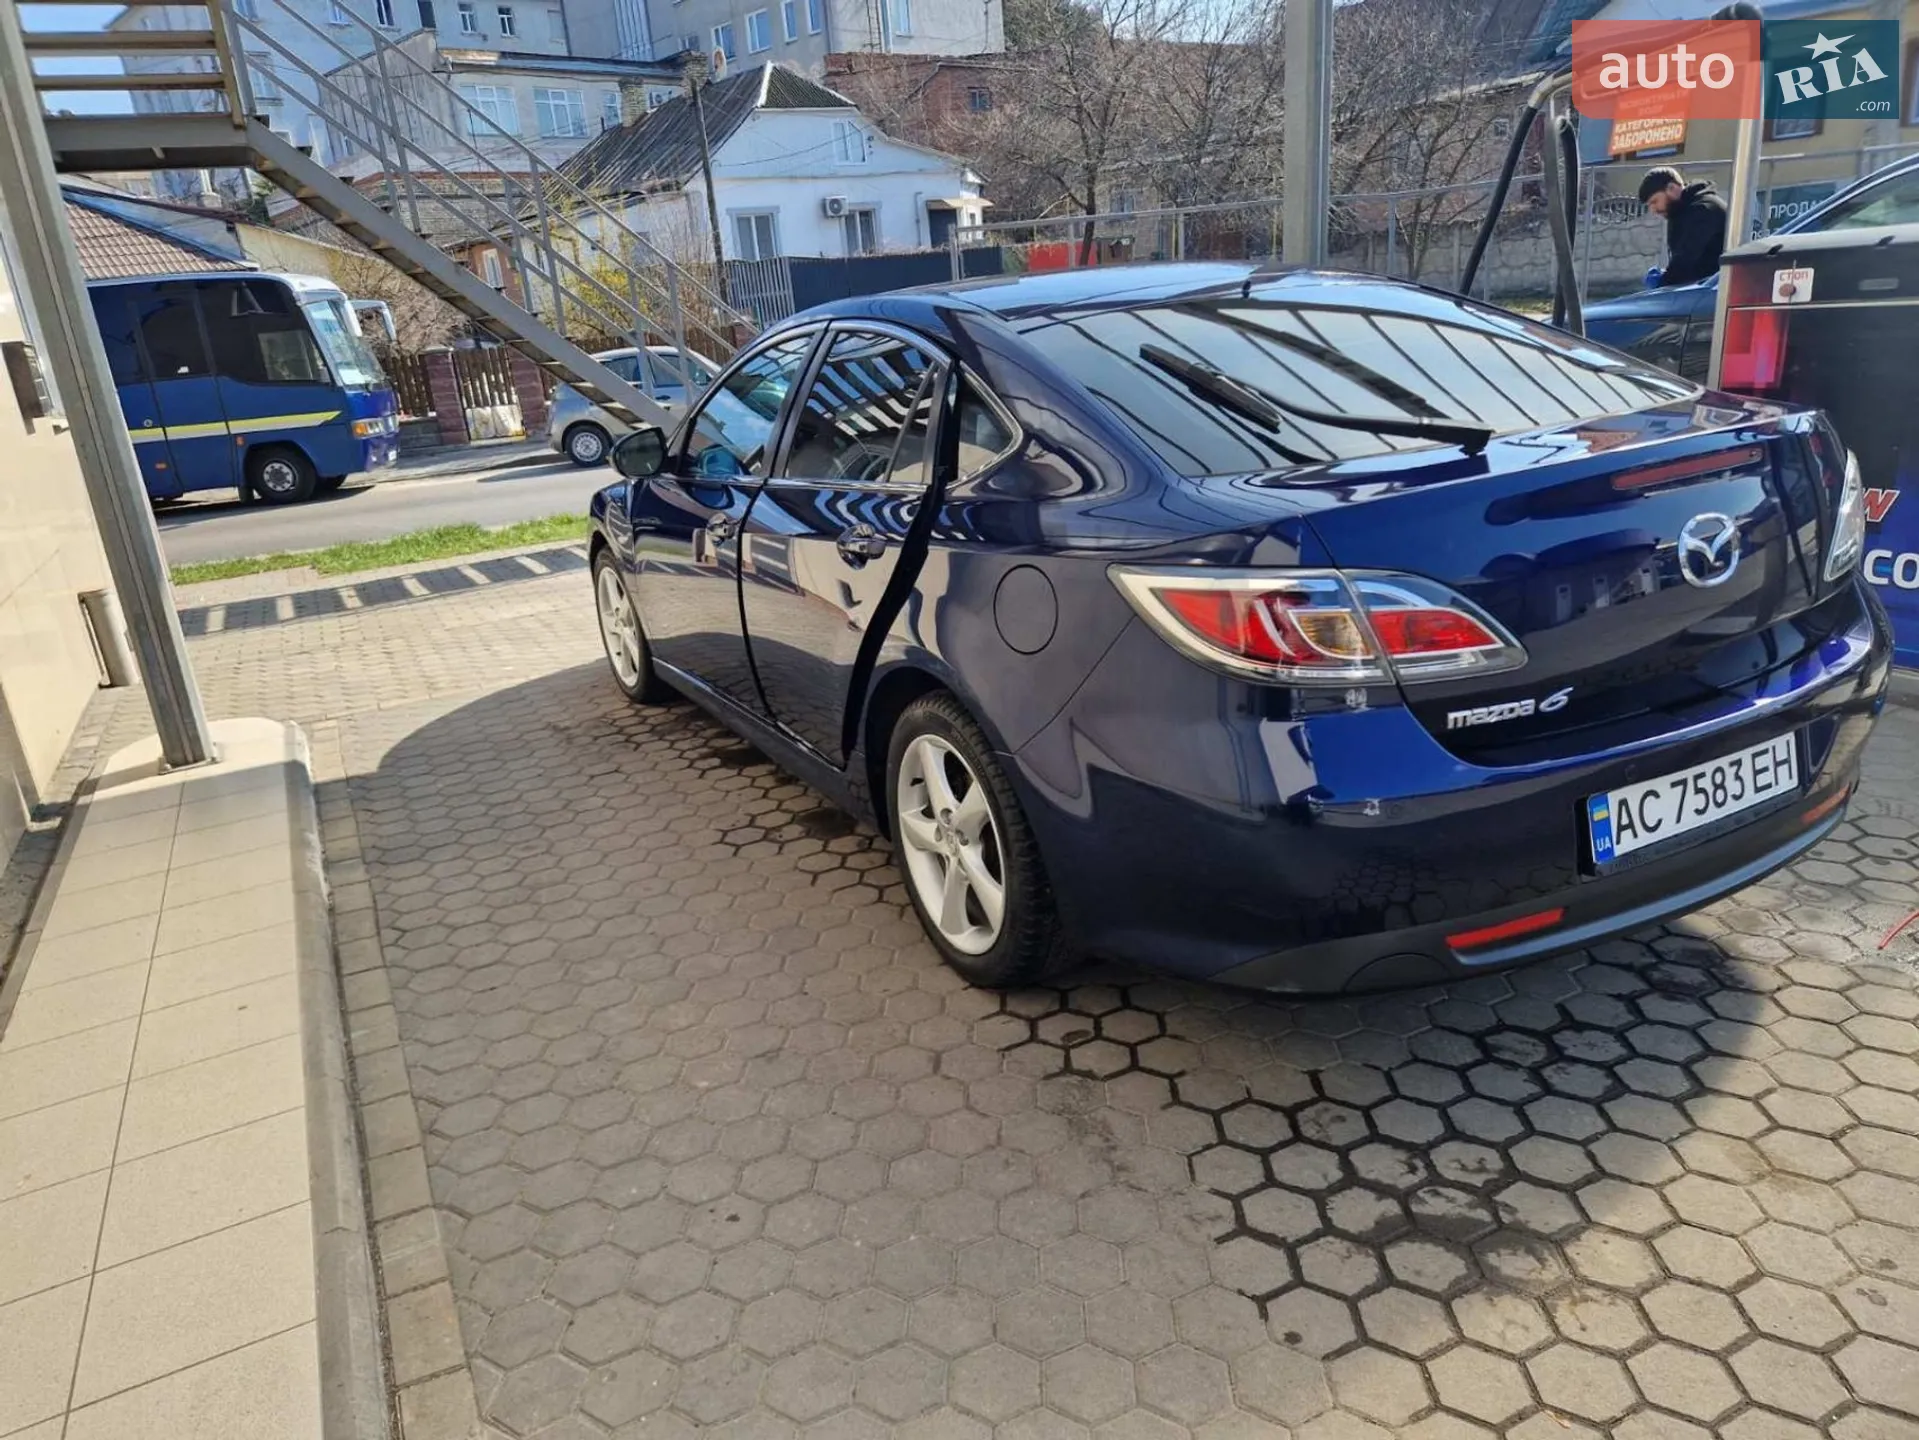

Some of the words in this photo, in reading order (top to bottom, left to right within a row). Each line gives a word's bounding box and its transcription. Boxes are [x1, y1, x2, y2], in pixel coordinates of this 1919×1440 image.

[1612, 123, 1684, 150] ЗАБОРОНЕНО
[1539, 686, 1574, 713] 6
[1615, 788, 1664, 846] AC
[1670, 757, 1746, 830] 7583
[1751, 739, 1794, 794] EH
[1596, 839, 1612, 852] UA
